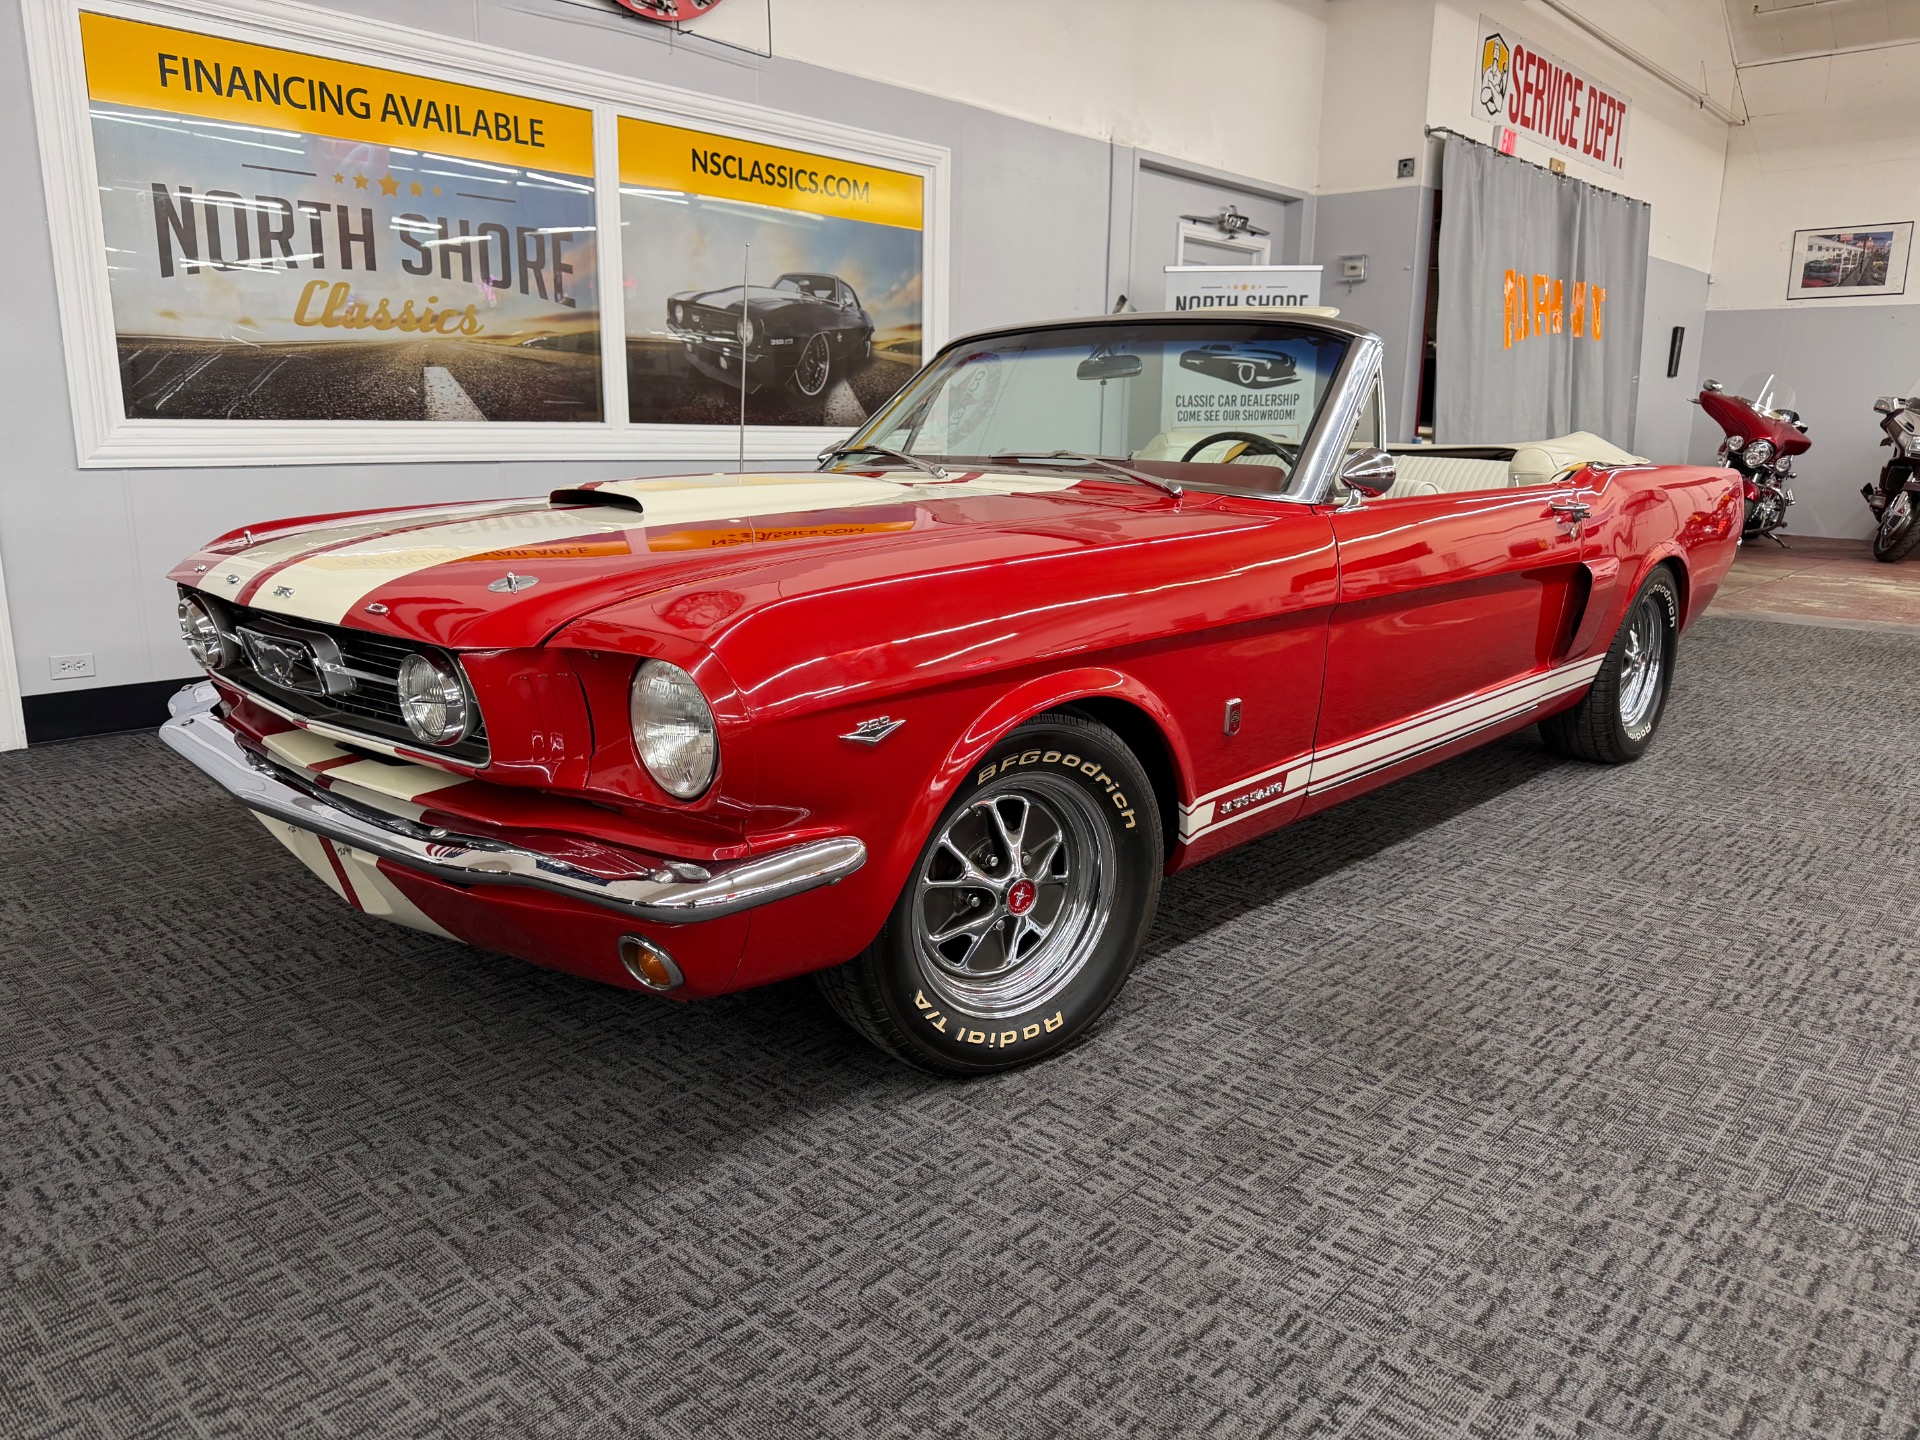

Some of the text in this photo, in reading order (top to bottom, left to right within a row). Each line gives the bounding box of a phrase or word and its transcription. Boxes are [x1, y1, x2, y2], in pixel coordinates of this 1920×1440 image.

[157, 52, 545, 148] FINANCING AVAILABLE
[1508, 44, 1626, 169] SERVICE DEPT.
[691, 148, 870, 204] NSCLASSICS.COM
[151, 182, 576, 309] NORTH SHORE
[293, 279, 484, 336] Classics
[1175, 393, 1300, 408] CLASSIC CAR DEALERSHIP
[1177, 409, 1296, 422] COME SEE OUR SHOWROOM!
[1641, 583, 1676, 628] Goodrich
[977, 750, 1138, 830] BFGoodrich
[913, 988, 1066, 1049] Radial T/A
